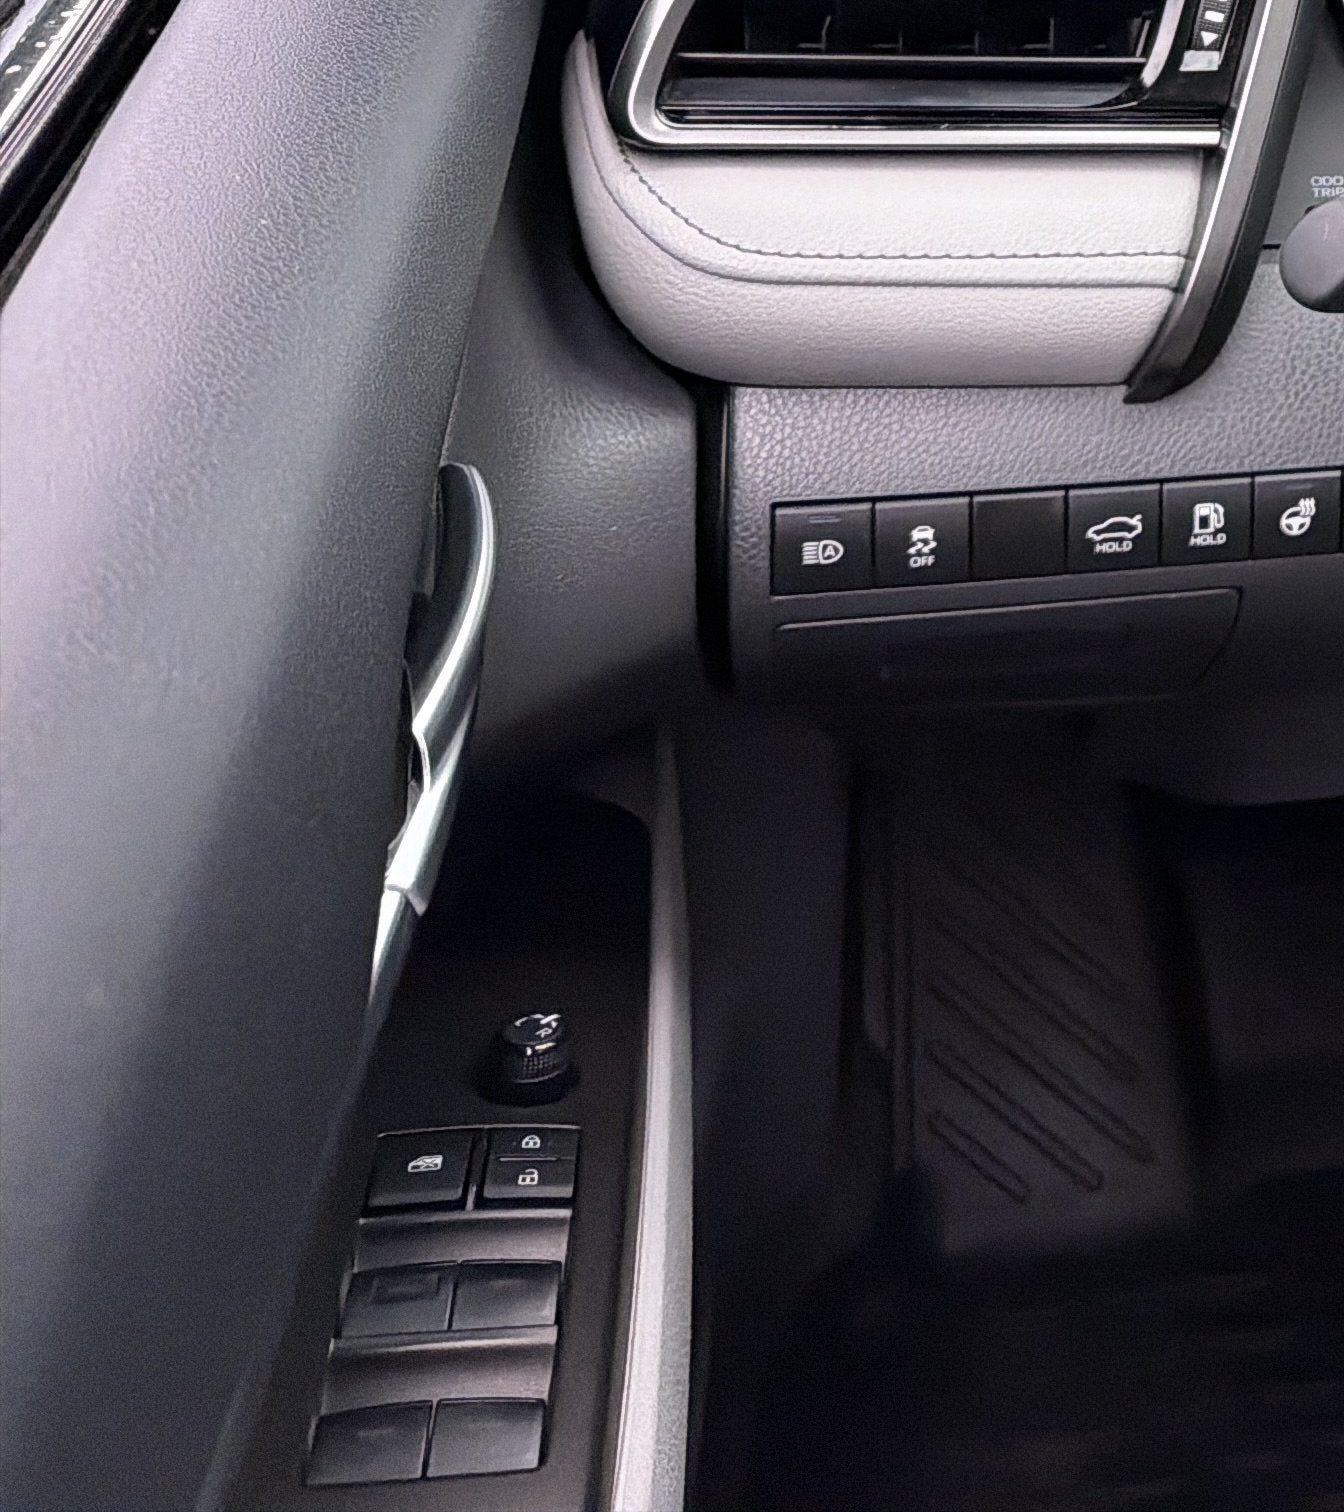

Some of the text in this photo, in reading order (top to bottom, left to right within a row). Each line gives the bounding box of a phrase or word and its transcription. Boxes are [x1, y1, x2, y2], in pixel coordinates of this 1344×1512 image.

[1311, 175, 1344, 186] ODO
[1312, 186, 1344, 198] TRIP
[1189, 533, 1227, 547] HOLD
[1094, 540, 1133, 554] HOLD
[909, 555, 935, 568] OFF
